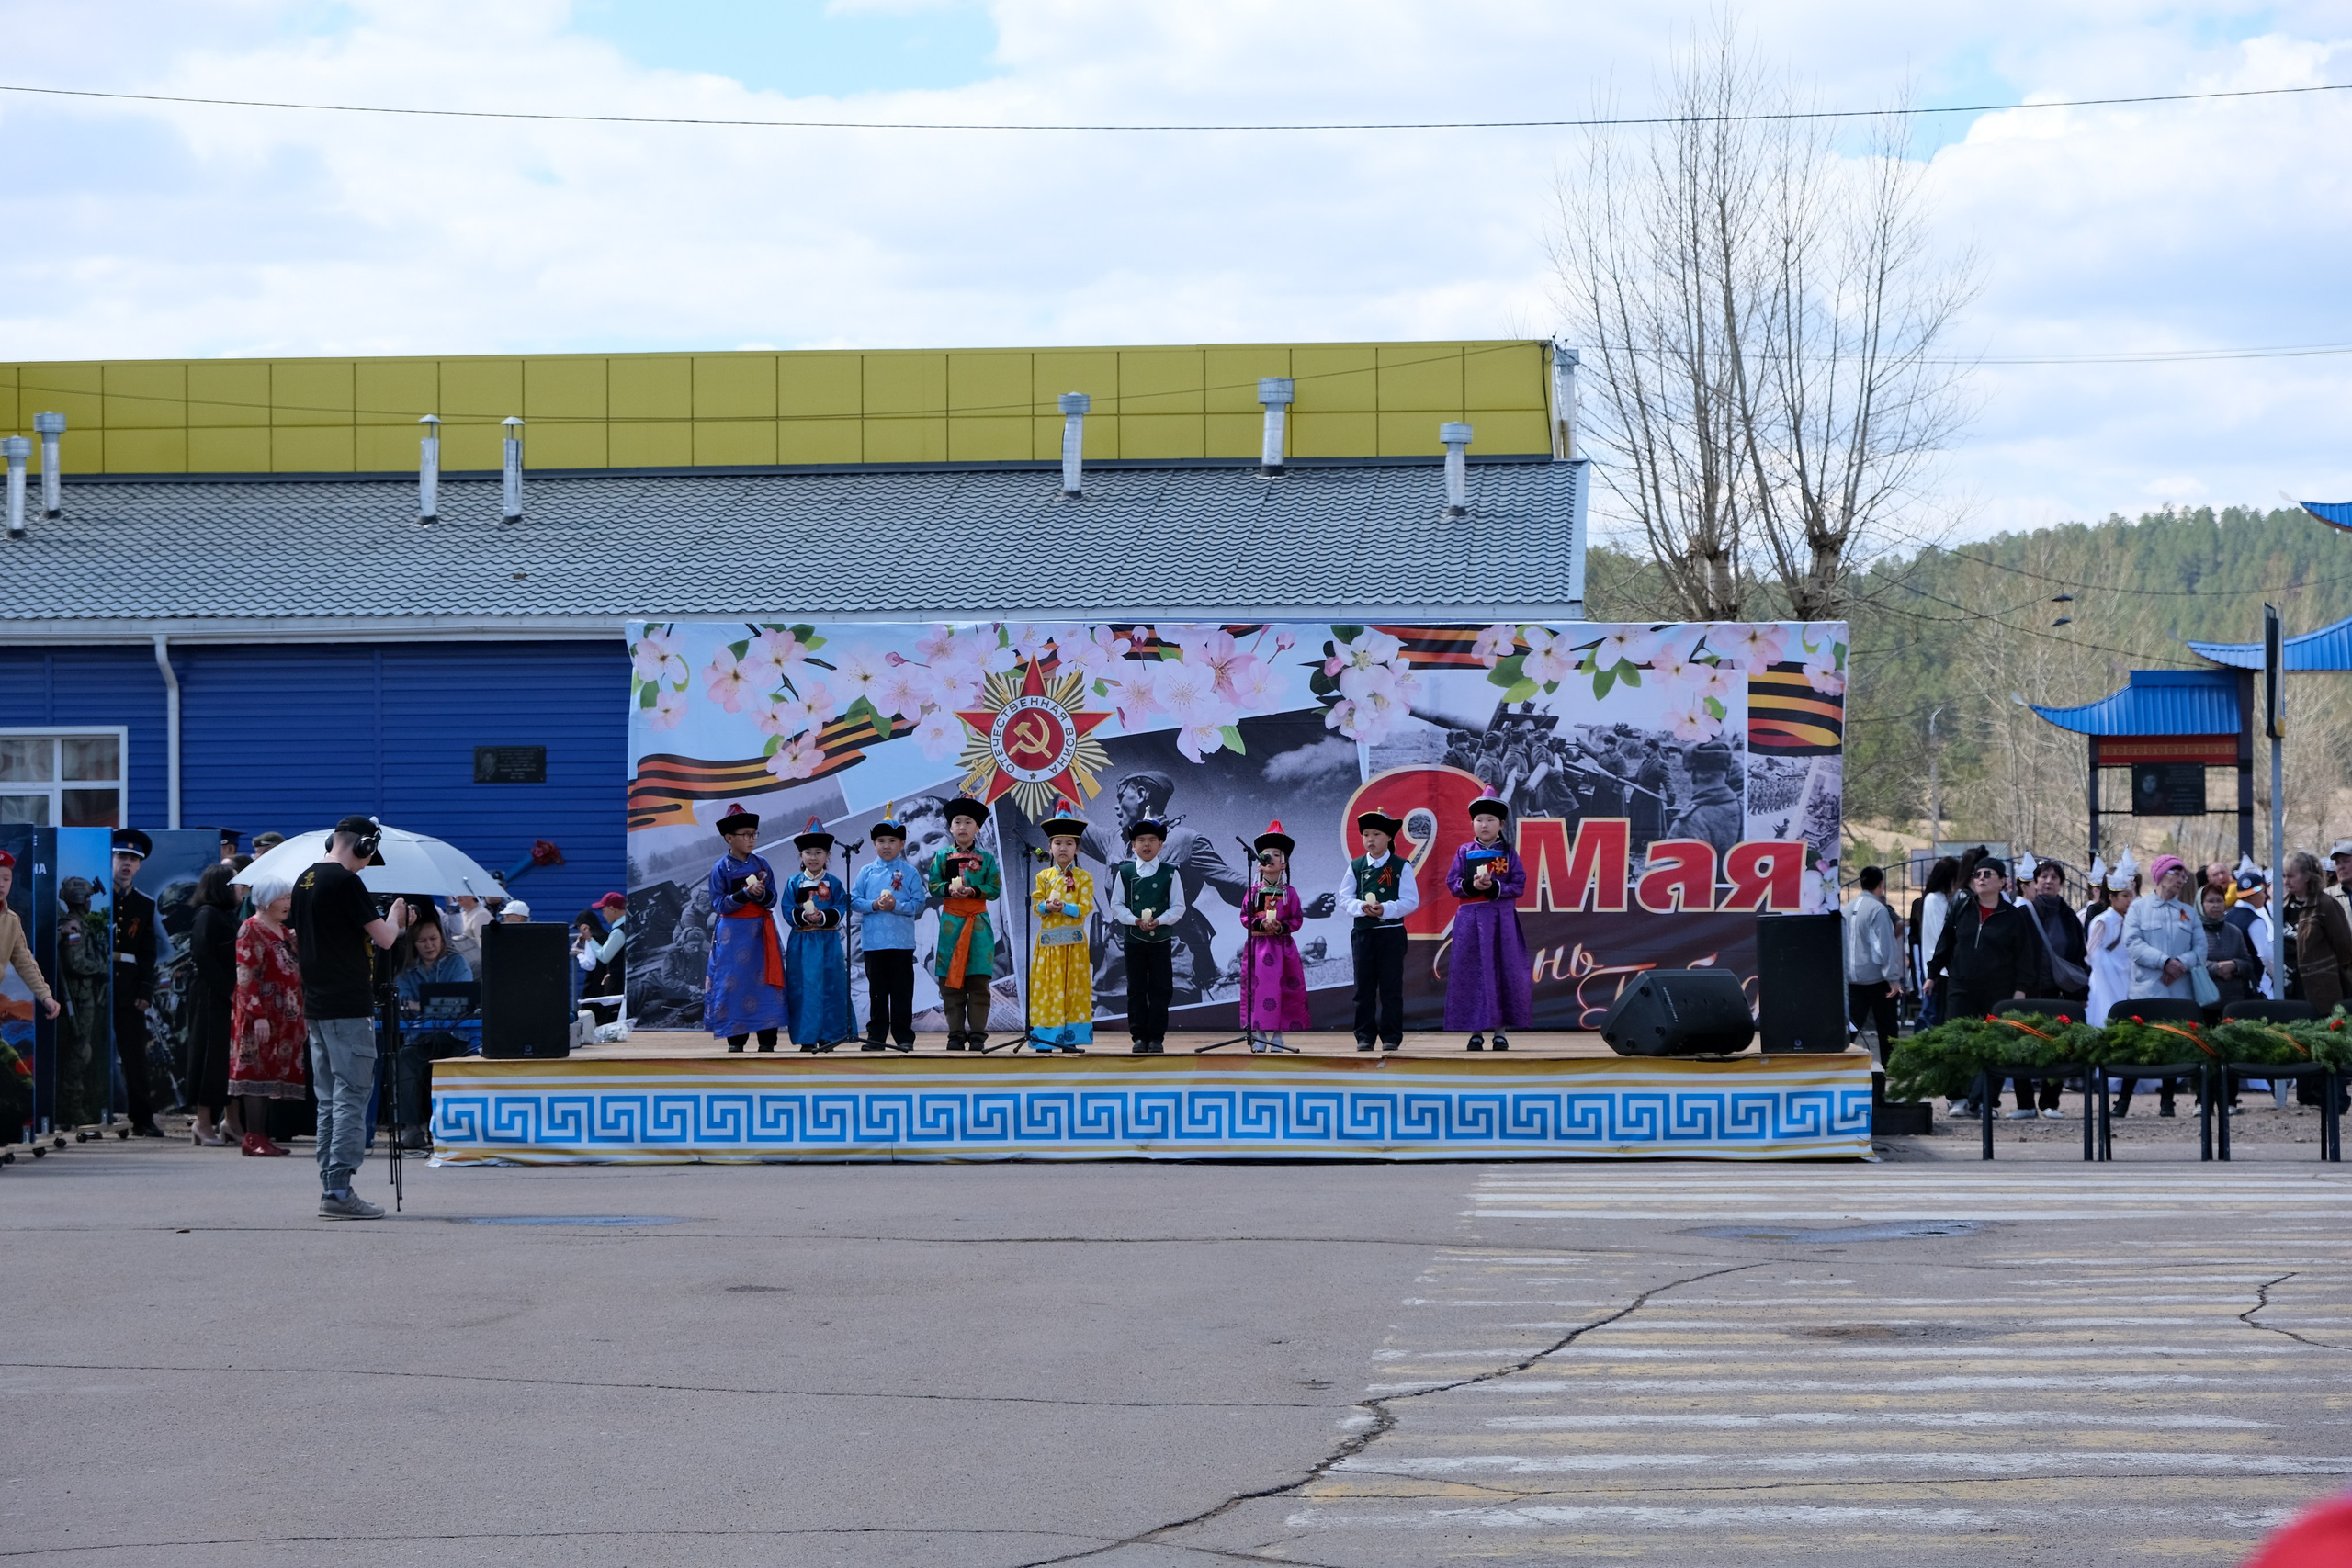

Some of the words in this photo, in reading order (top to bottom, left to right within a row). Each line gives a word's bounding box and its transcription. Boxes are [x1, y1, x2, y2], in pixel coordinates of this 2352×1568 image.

[992, 697, 1069, 773] ОТЕЧЕСТВЕННАЯ
[1048, 727, 1075, 774] ВОЙНА
[1342, 764, 1495, 940] 9
[1515, 817, 1808, 913] Мая
